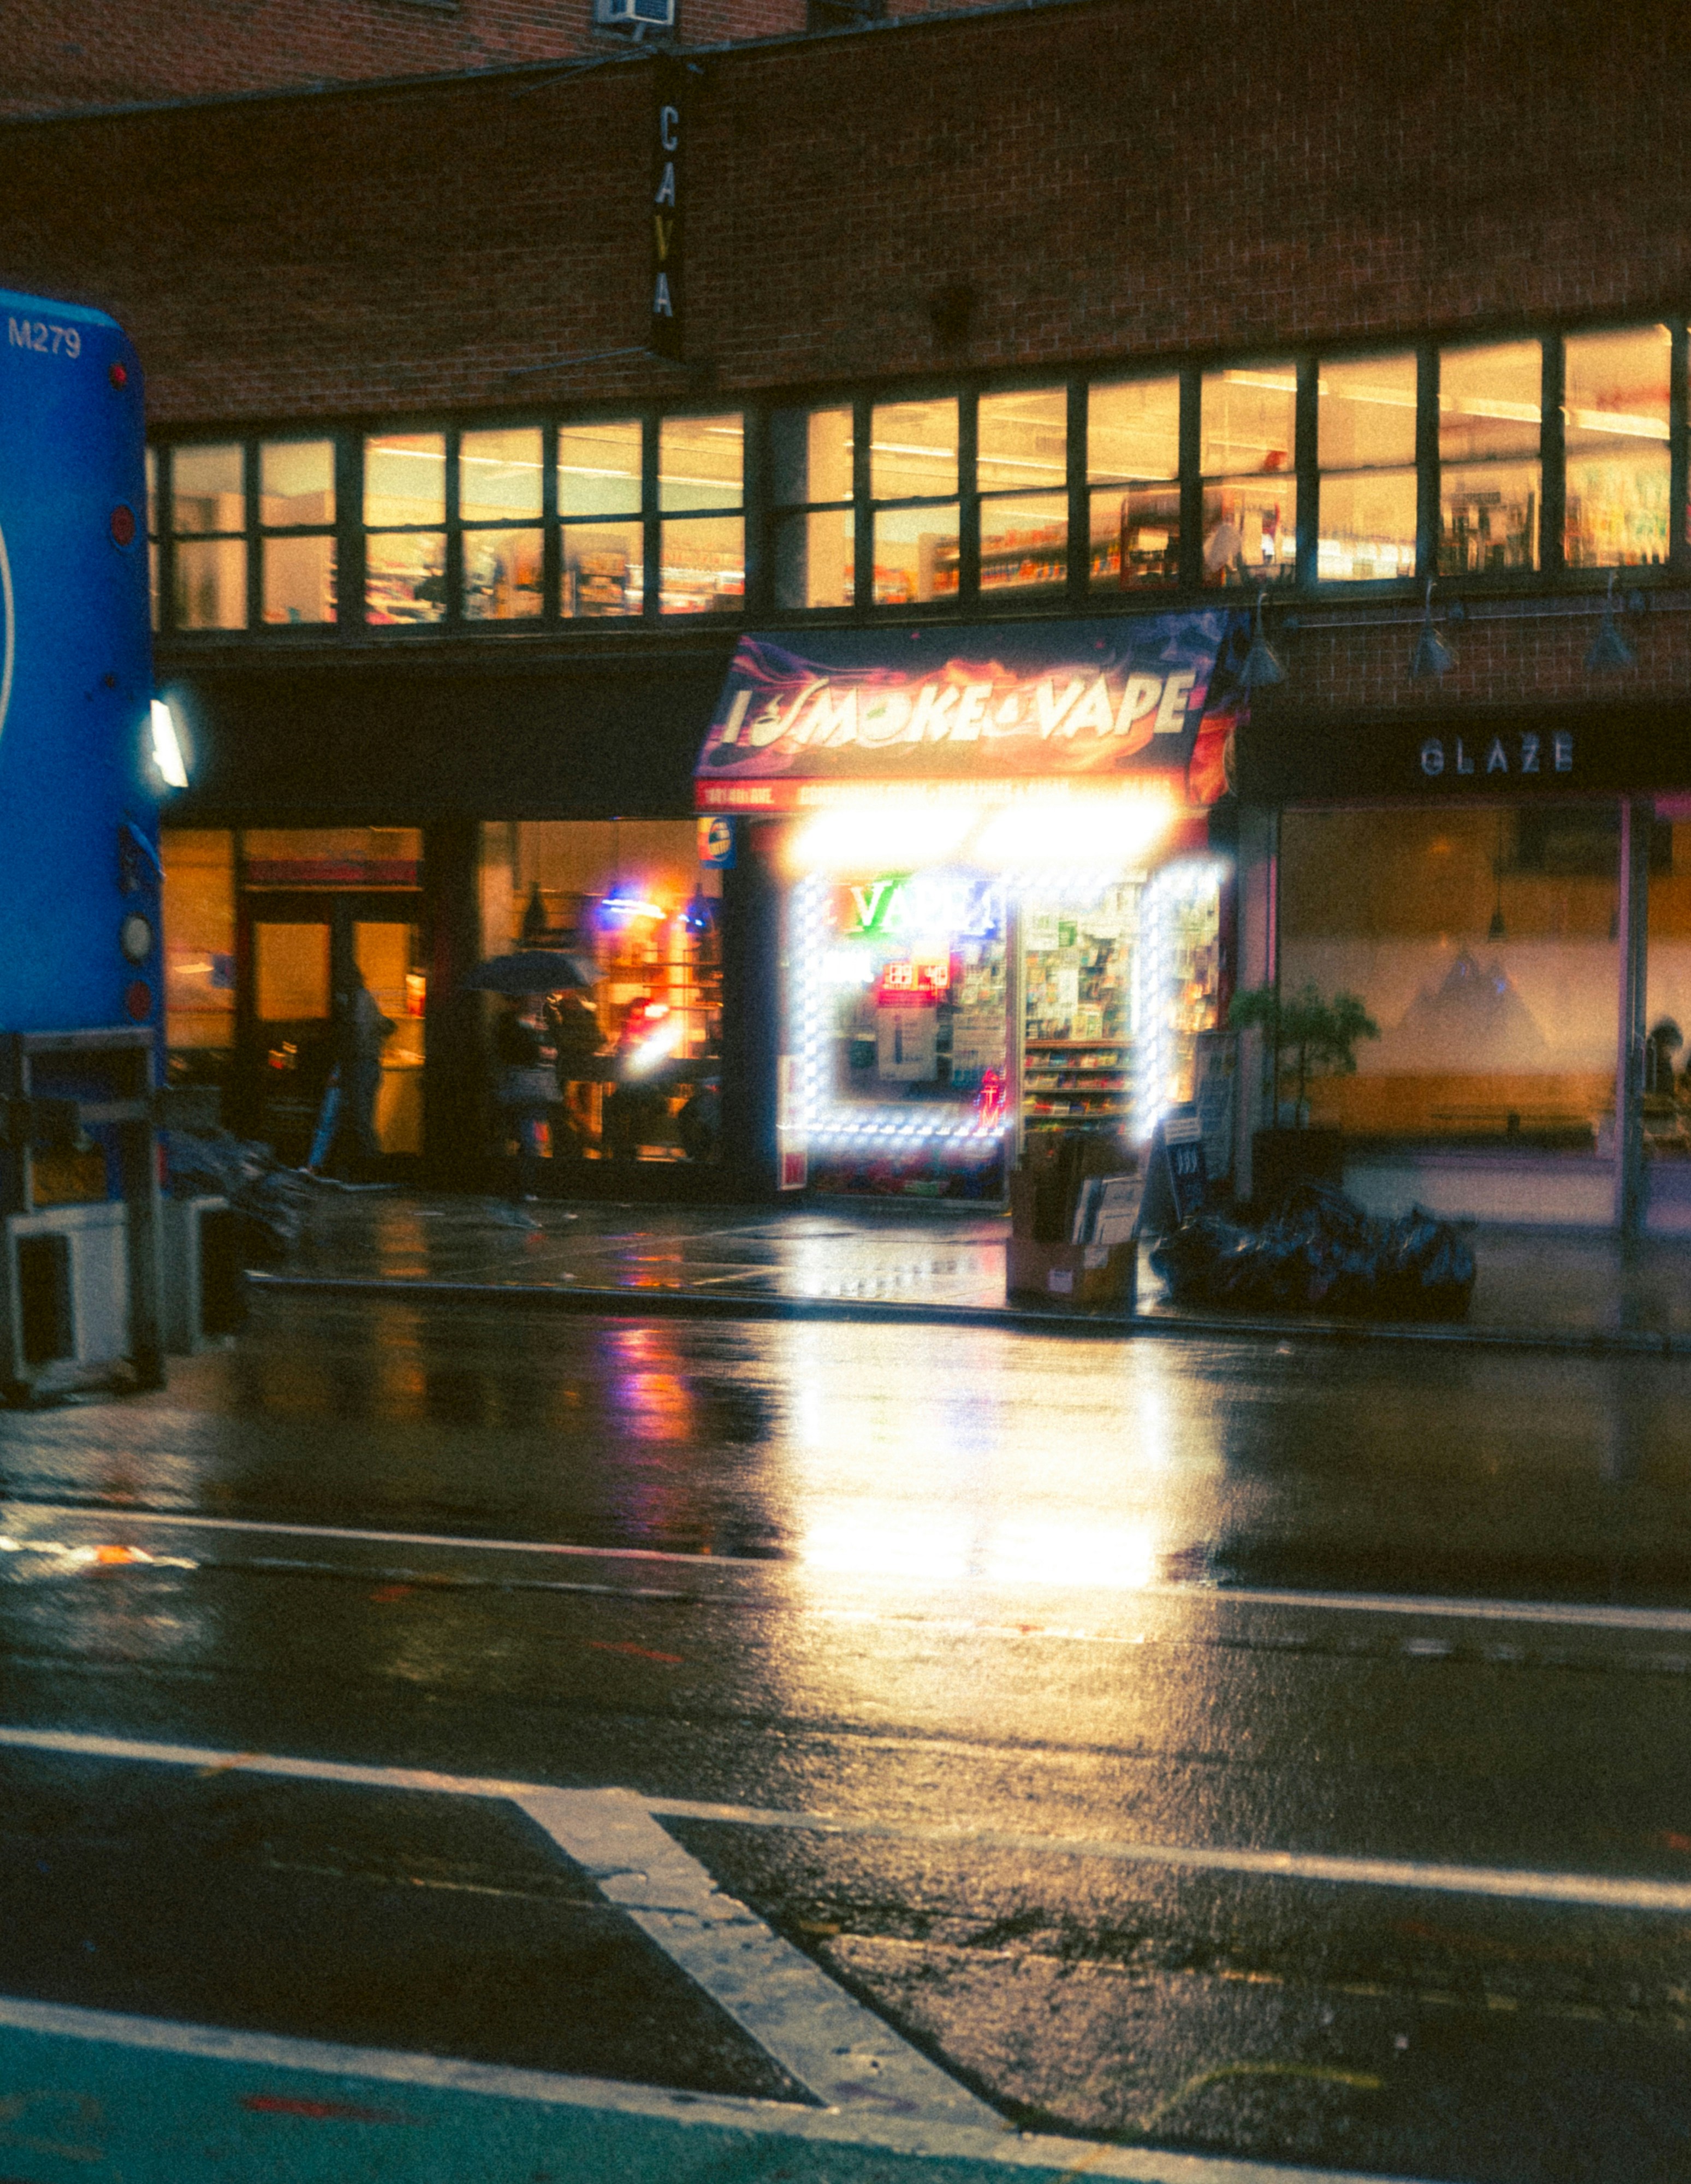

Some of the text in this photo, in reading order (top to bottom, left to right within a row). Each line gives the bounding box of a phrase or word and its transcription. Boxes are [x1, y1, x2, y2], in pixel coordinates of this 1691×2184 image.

[655, 106, 679, 317] CAVA
[9, 317, 81, 359] M279
[750, 676, 993, 748] SMOKE
[1036, 671, 1196, 741] VAPE
[1421, 730, 1573, 776] GLAZE
